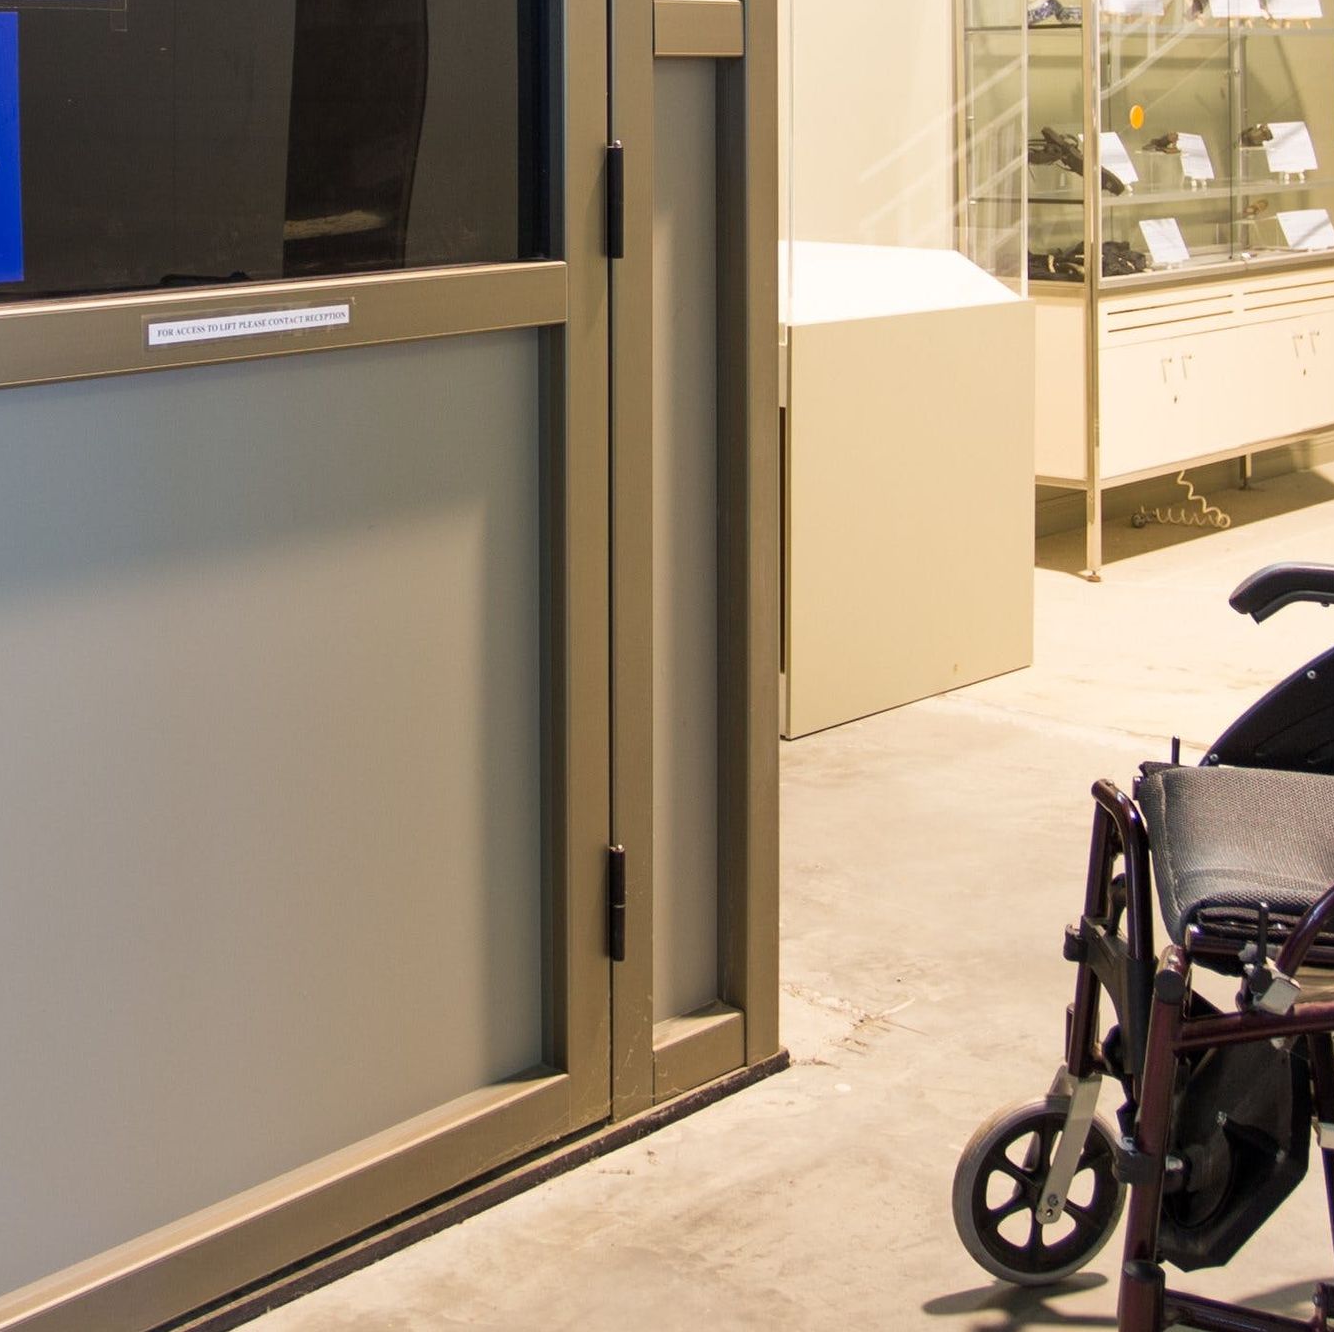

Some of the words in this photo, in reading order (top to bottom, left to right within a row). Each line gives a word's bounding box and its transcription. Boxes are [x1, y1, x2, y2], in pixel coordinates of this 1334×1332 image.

[157, 328, 174, 338] FOR
[176, 325, 205, 336] ACCESS
[207, 323, 218, 333] TO
[219, 322, 237, 332] LIFT
[238, 320, 266, 330] PLEASE
[268, 315, 303, 327] CONTACT
[305, 311, 347, 323] RECEPTION
